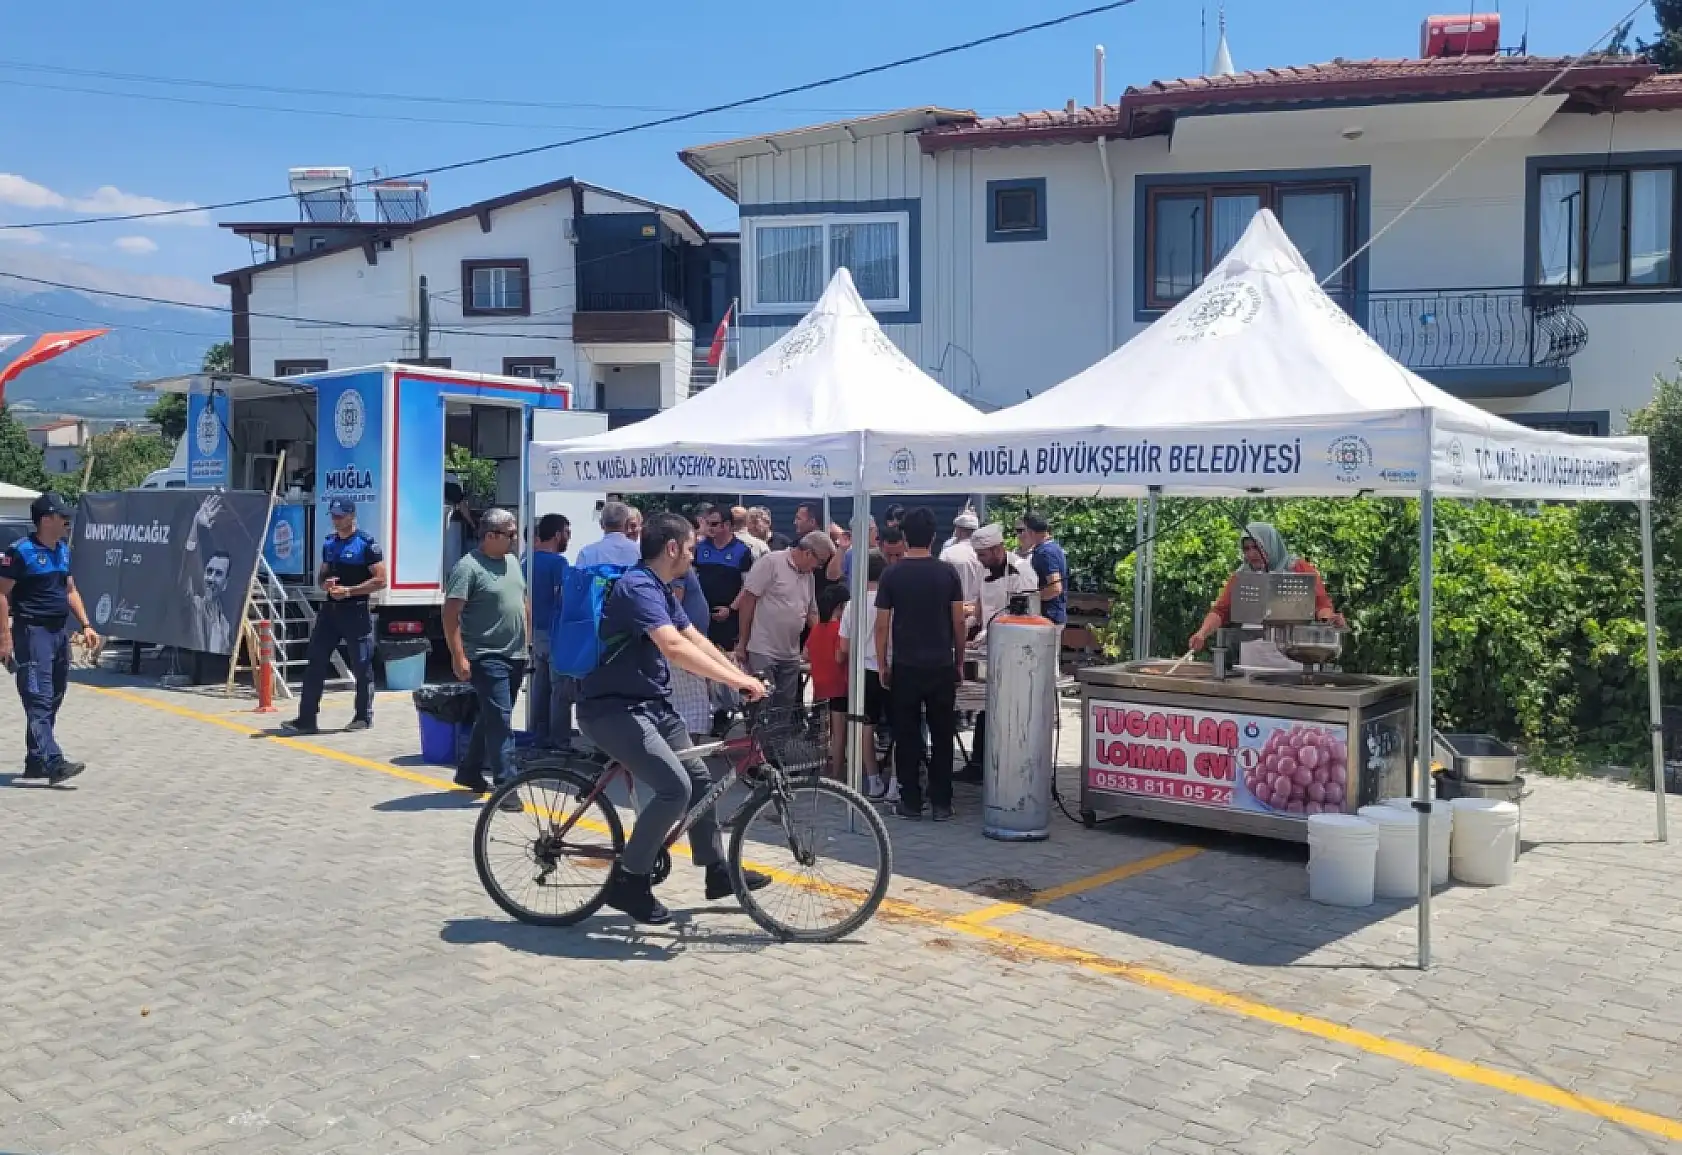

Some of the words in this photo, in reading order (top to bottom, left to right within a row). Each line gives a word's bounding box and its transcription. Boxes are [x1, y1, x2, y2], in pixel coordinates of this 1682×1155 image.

[573, 460, 597, 481] T.C.
[598, 456, 637, 479] MUĞLA
[640, 451, 716, 480] BÜYÜKŞEHİR
[717, 454, 793, 482] BELEDİYESİ
[933, 452, 963, 477] T.C.
[968, 446, 1030, 476] MUĞLA
[1036, 440, 1162, 476] BÜYÜKŞEHİR
[1169, 438, 1301, 474] BELEDİYESİ
[325, 463, 373, 490] MUĞLA
[84, 519, 171, 544] UNUTMAYACAĞIZ
[1096, 738, 1188, 775] LOKMA
[1096, 772, 1139, 790] 0533
[1144, 779, 1175, 796] 811
[1183, 784, 1205, 799] 05
[1211, 788, 1234, 804] 24
